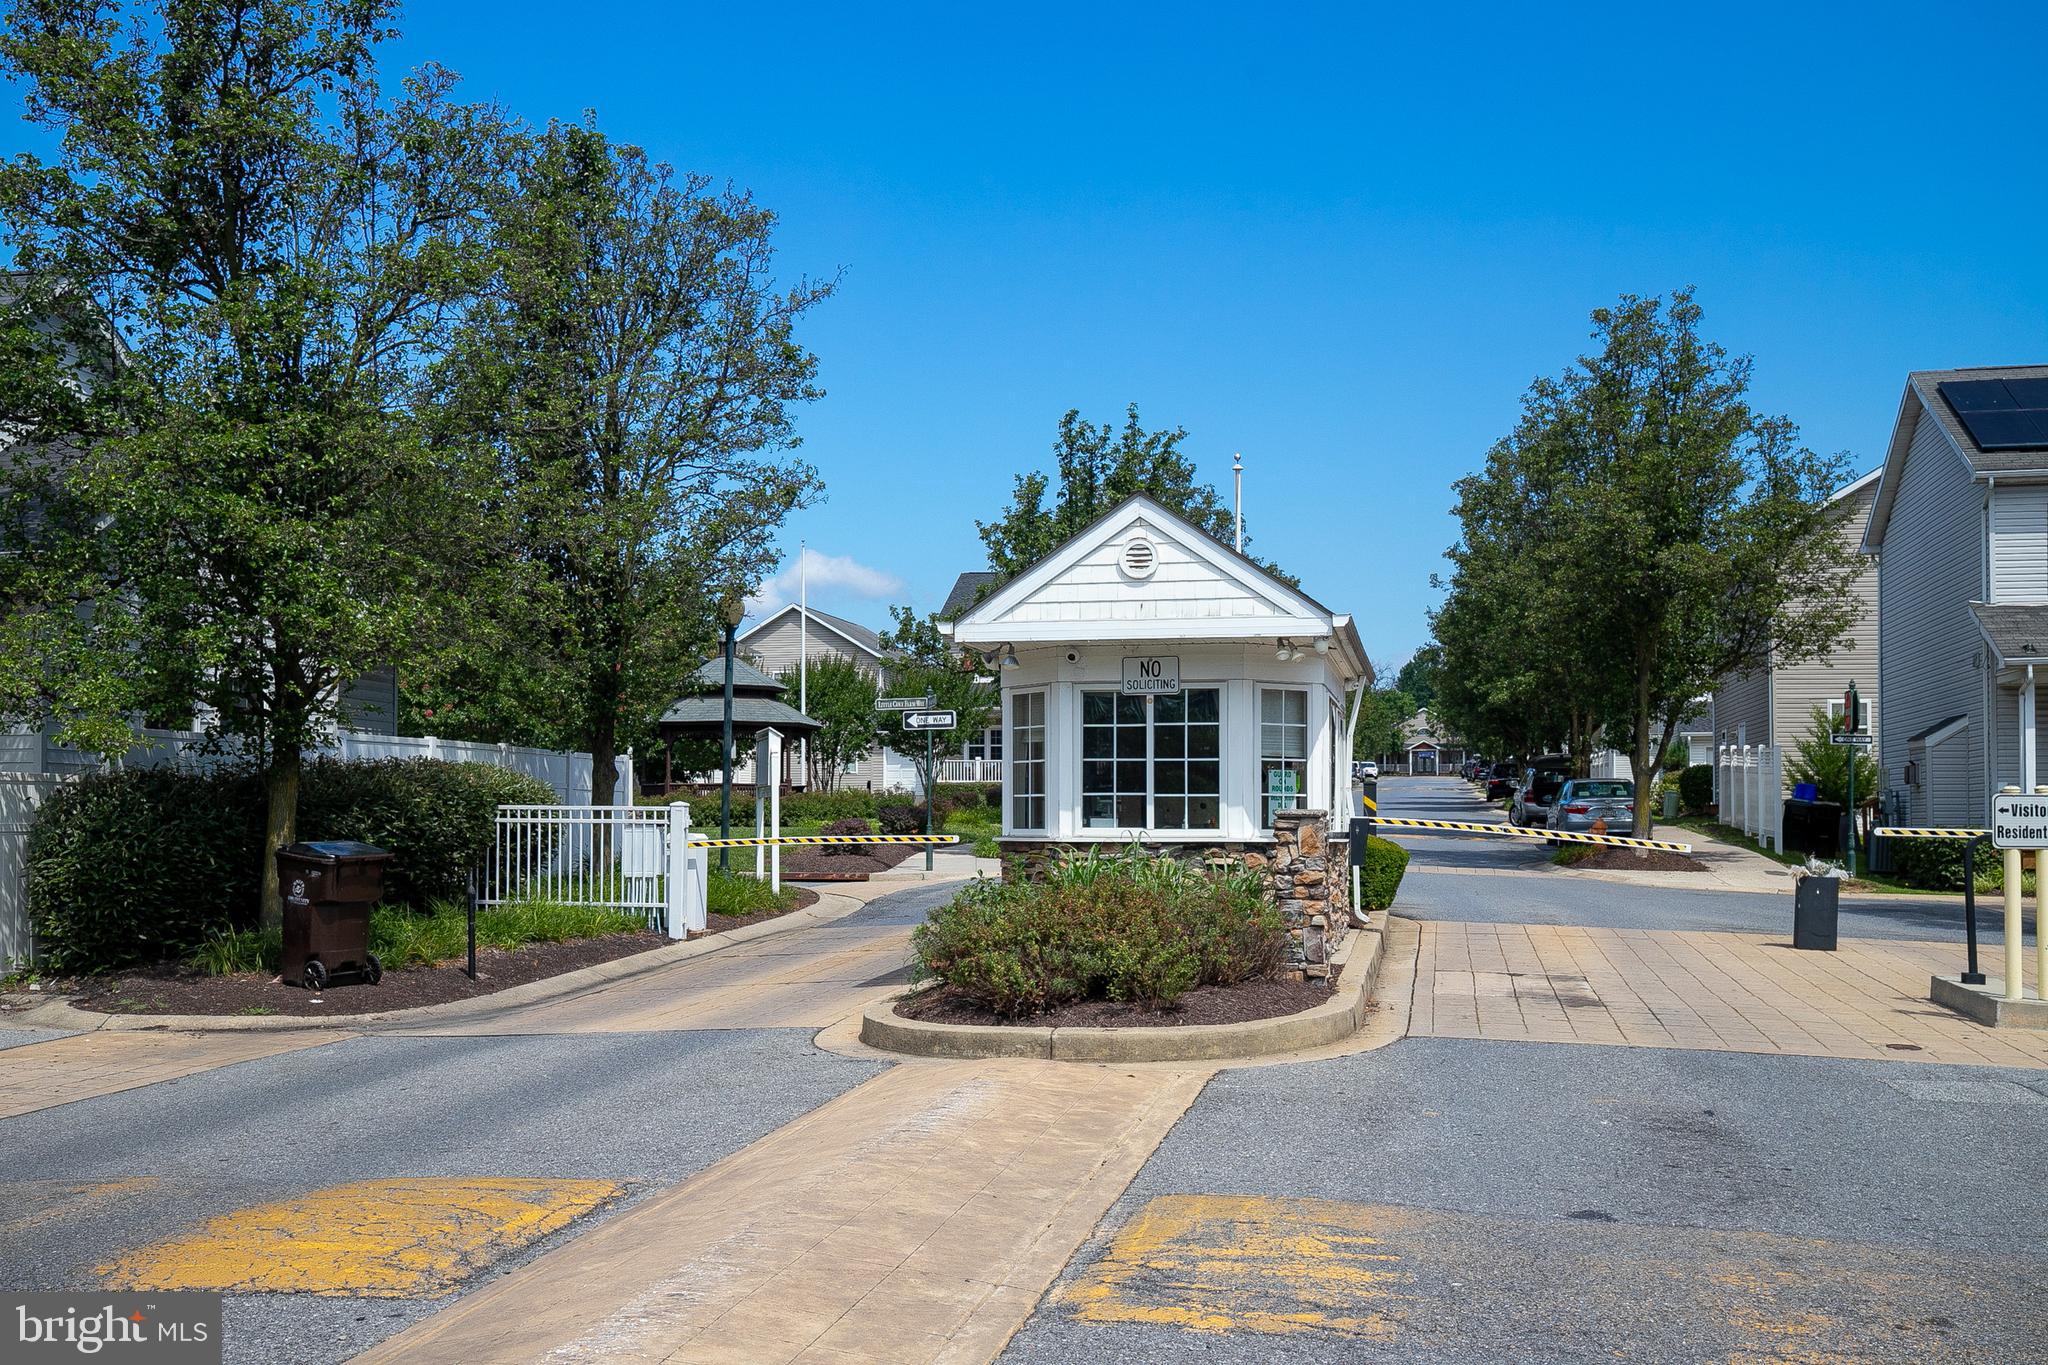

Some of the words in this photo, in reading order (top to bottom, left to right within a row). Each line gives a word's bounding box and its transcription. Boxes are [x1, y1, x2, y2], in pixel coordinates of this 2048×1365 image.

[1140, 660, 1161, 678] NO
[1126, 679, 1176, 690] SOLICITING
[1273, 770, 1292, 778] GURD
[2010, 803, 2048, 817] Visito
[1997, 825, 2047, 839] Resident
